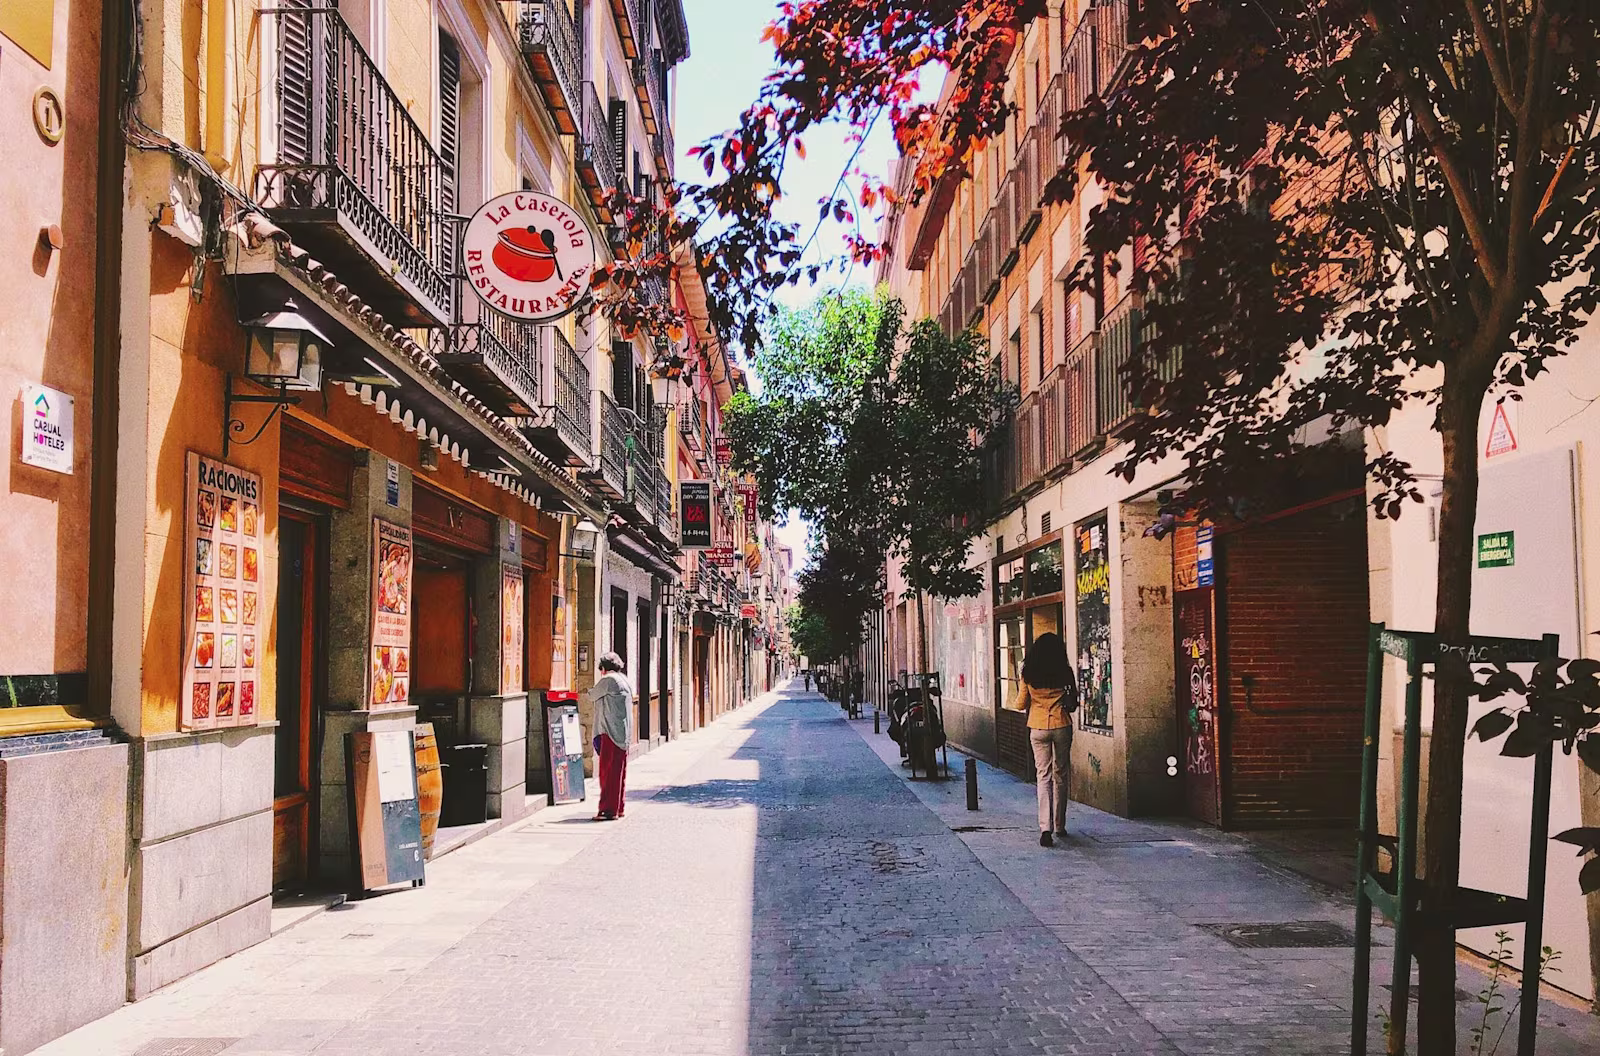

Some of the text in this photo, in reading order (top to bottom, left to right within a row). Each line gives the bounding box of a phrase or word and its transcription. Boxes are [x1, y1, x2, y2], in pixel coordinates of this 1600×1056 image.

[485, 194, 584, 249] La Caserola
[33, 418, 62, 437] CASUAL
[33, 432, 65, 451] HOTELES
[199, 461, 257, 500] RACIONES
[738, 484, 761, 492] HOSTA
[747, 495, 755, 521] LIDO
[1482, 536, 1509, 549] SALIDA DE
[1480, 548, 1512, 562] EMERGENCIA
